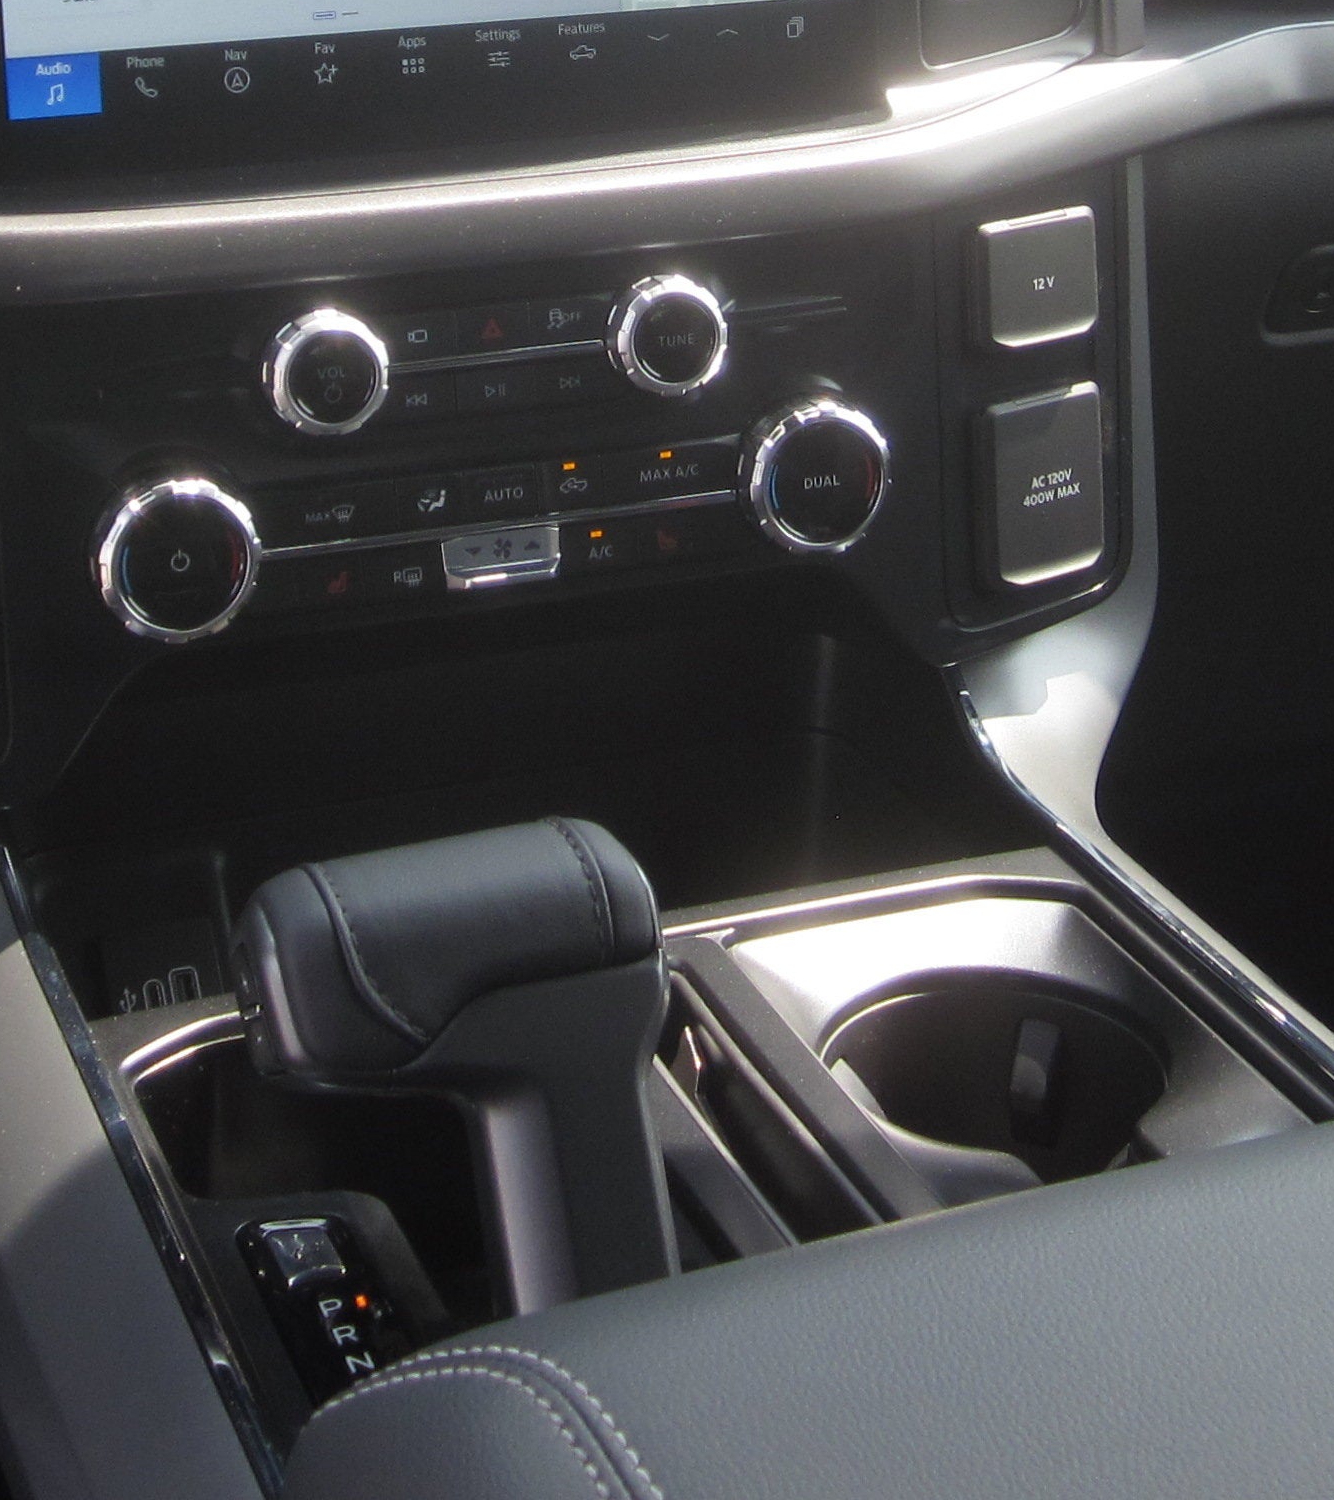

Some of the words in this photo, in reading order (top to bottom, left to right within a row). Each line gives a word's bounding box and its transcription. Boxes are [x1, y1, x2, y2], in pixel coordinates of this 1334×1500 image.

[475, 27, 521, 43] Settings
[558, 21, 605, 36] Features
[314, 42, 335, 54] Fav
[397, 35, 426, 50] Apps
[127, 55, 164, 69] Phone
[225, 49, 248, 61] Nav
[36, 62, 71, 76] Audio
[1033, 278, 1045, 291] 12
[1046, 276, 1055, 288] V
[658, 333, 695, 347] TUNE
[640, 468, 667, 483] MAX
[675, 463, 700, 480] A/C
[1031, 476, 1045, 489] AC
[1047, 468, 1073, 485] 120V
[804, 475, 840, 490] DUAL
[484, 487, 523, 502] AUTO
[1023, 489, 1055, 507] 400W
[1057, 483, 1081, 500] MAX
[305, 512, 331, 524] MAX
[589, 544, 613, 558] A/C
[319, 1298, 343, 1318] P
[332, 1325, 359, 1347] R
[345, 1351, 375, 1374] N
